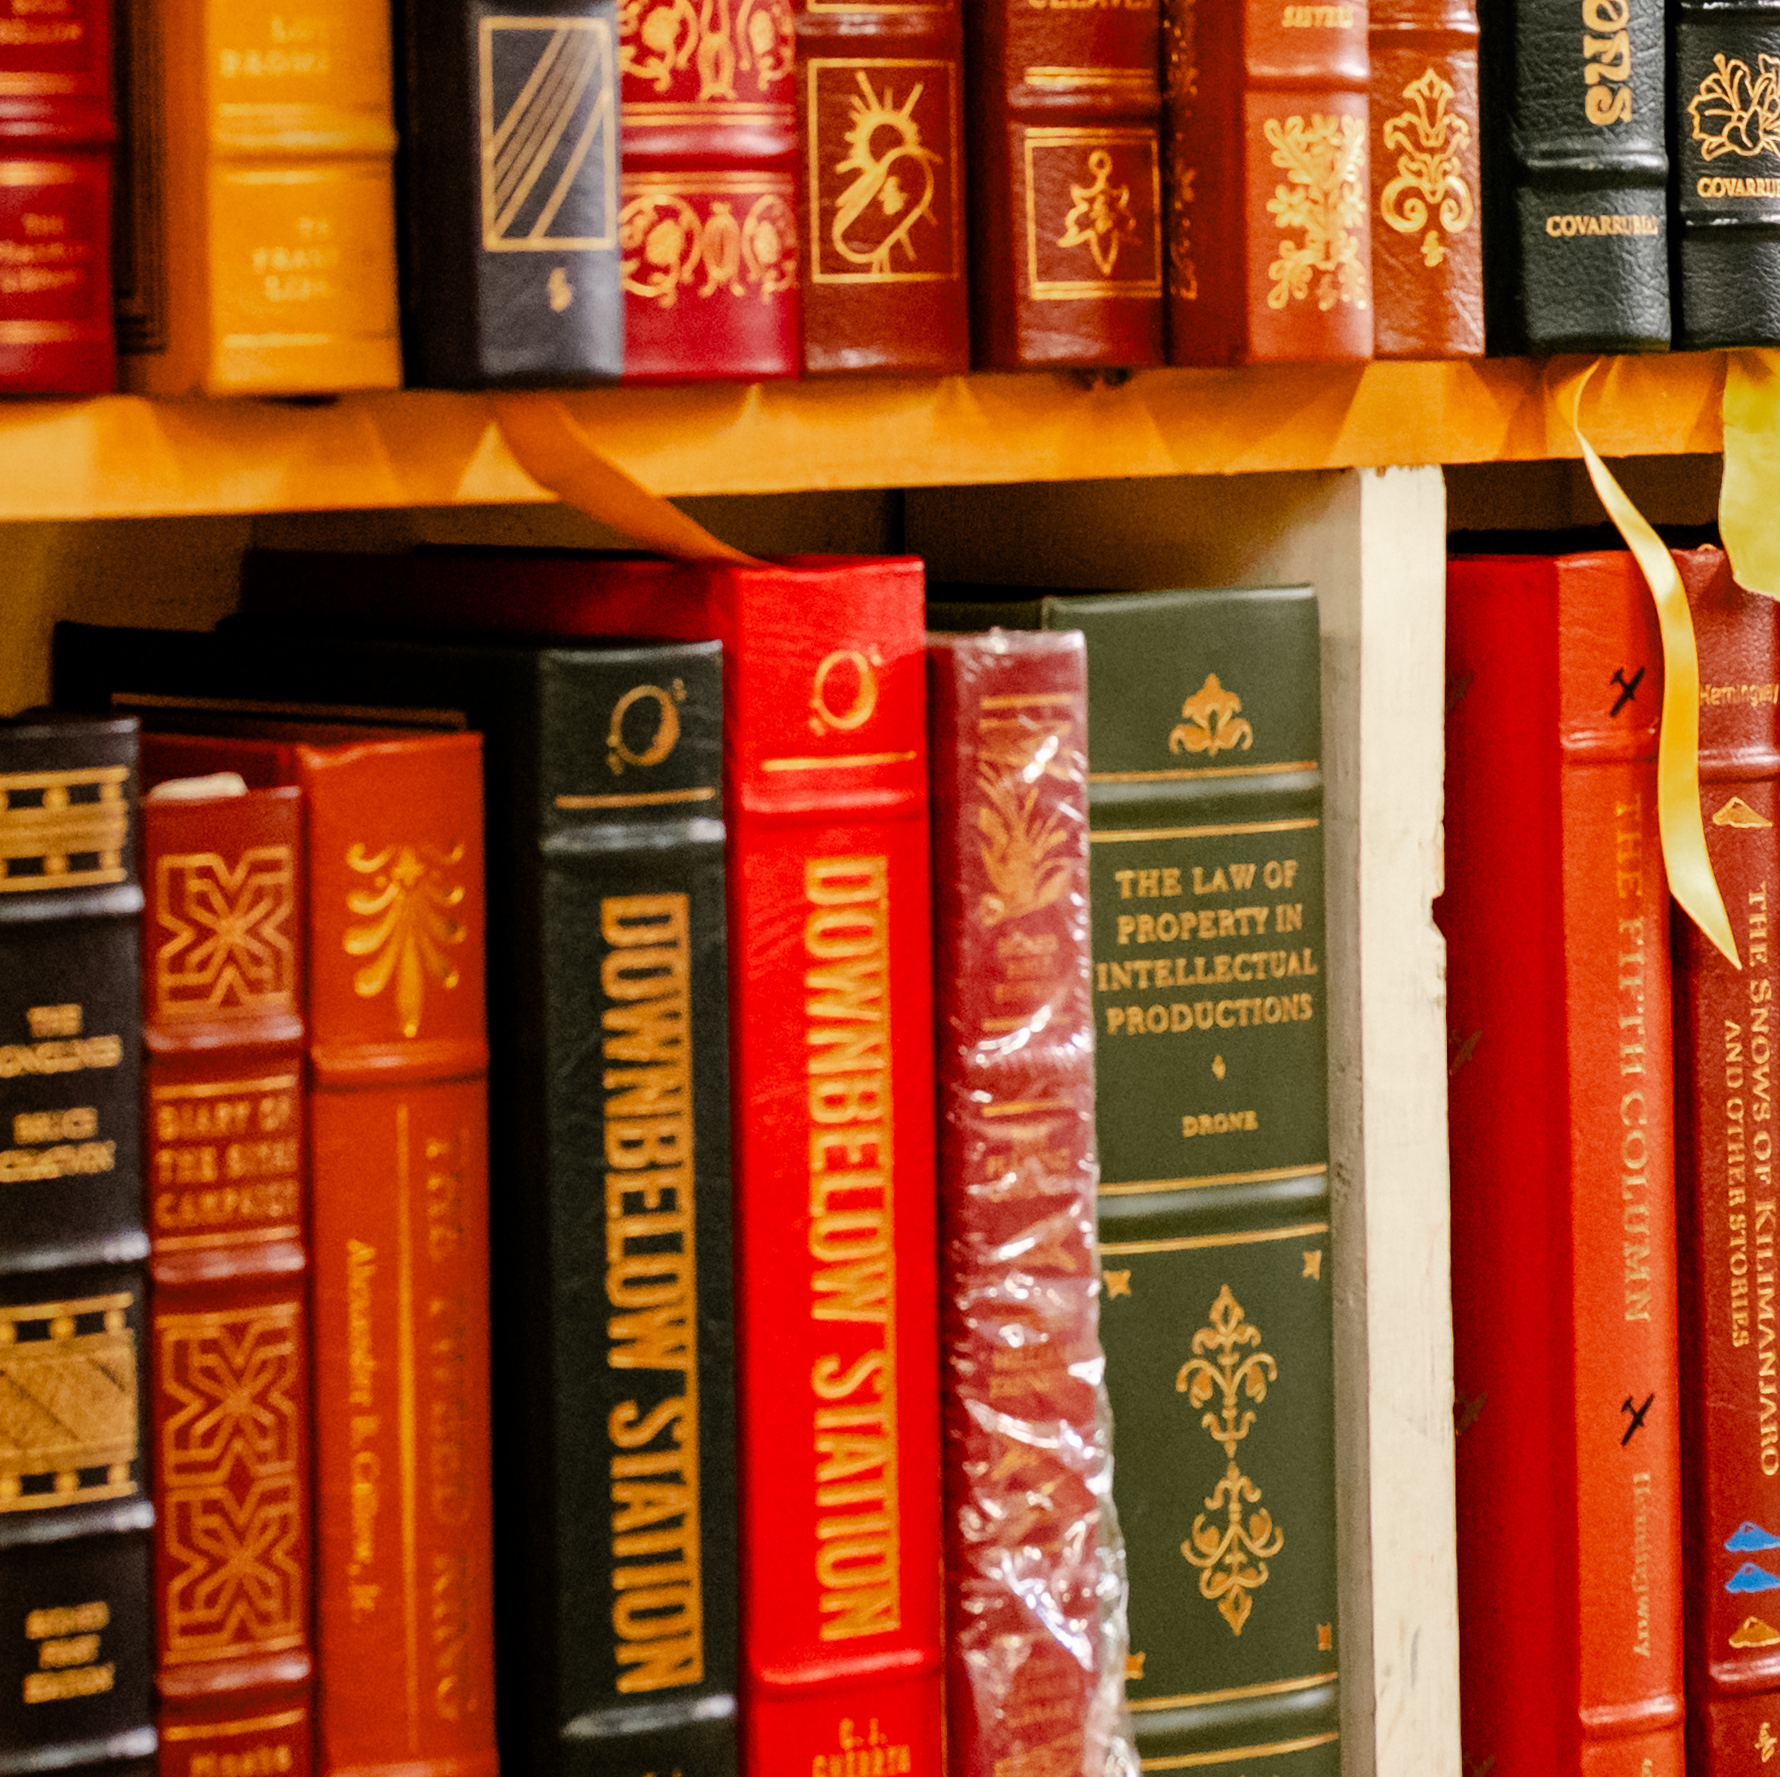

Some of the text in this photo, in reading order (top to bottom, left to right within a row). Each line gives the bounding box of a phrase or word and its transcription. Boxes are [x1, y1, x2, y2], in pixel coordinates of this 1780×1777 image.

[1097, 948, 1317, 991] INTELLECTUAL
[1116, 860, 1298, 899] THE LAW OF
[1117, 904, 1302, 944] PROPERTY IN
[1106, 993, 1313, 1035] PRODUCTIONS
[1615, 796, 1652, 1322] THE FIFTH COLUMN
[1182, 1110, 1258, 1138] DRONE
[1724, 1021, 1750, 1348] AND OTHER STORIES
[1748, 882, 1779, 1476] THE SNOWS OF KILIMANJARO
[599, 893, 703, 1693] DOWNBELOW STATION
[804, 856, 900, 1644] DOWNBELOW STATION
